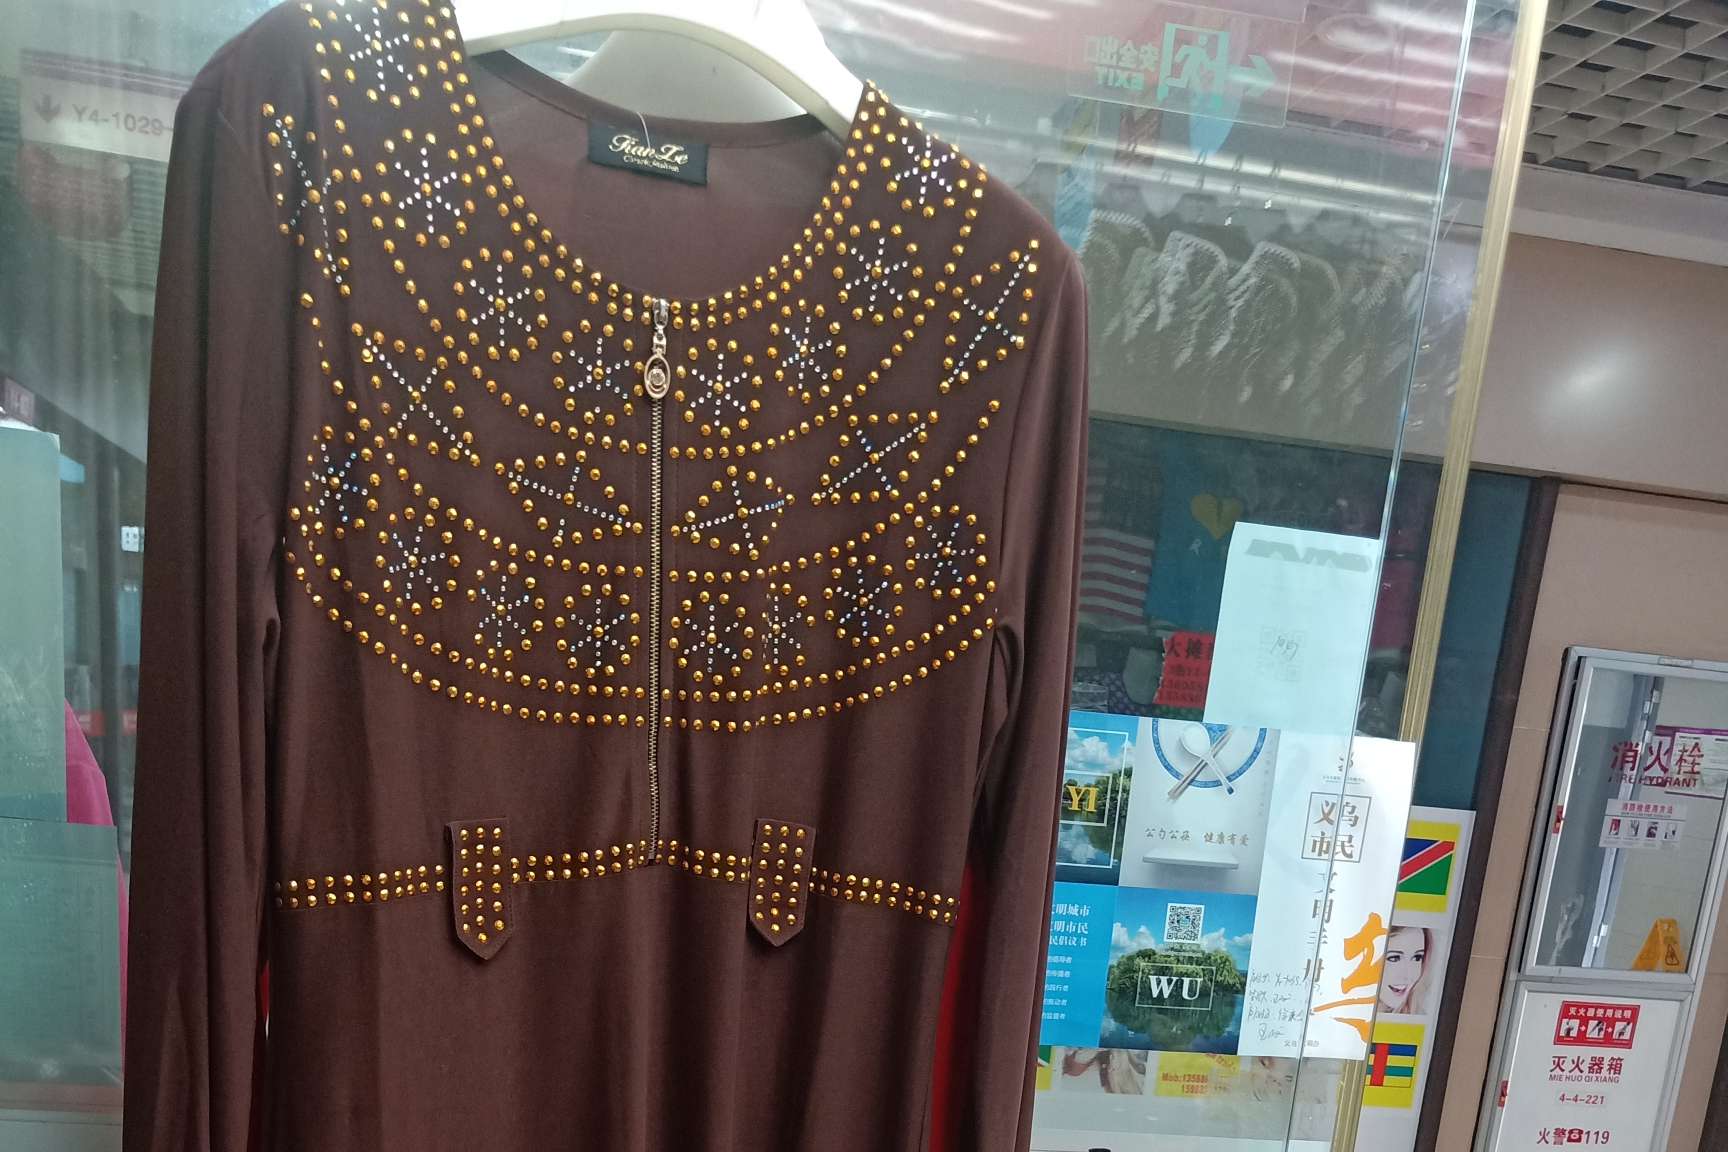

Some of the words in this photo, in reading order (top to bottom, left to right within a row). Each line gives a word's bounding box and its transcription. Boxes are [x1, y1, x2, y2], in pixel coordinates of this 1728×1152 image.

[1610, 740, 1704, 775] 消火栓
[1066, 785, 1098, 813] YI
[1549, 1055, 1625, 1076] 灭火器箱
[1548, 1074, 1564, 1082] MIE
[1564, 1074, 1583, 1083] HUO
[1584, 1075, 1593, 1083] QI
[1594, 1075, 1620, 1084] XIANG
[1559, 1092, 1605, 1105] 4-4-221
[1536, 1127, 1567, 1146] 火警
[1584, 1130, 1611, 1145] 119
